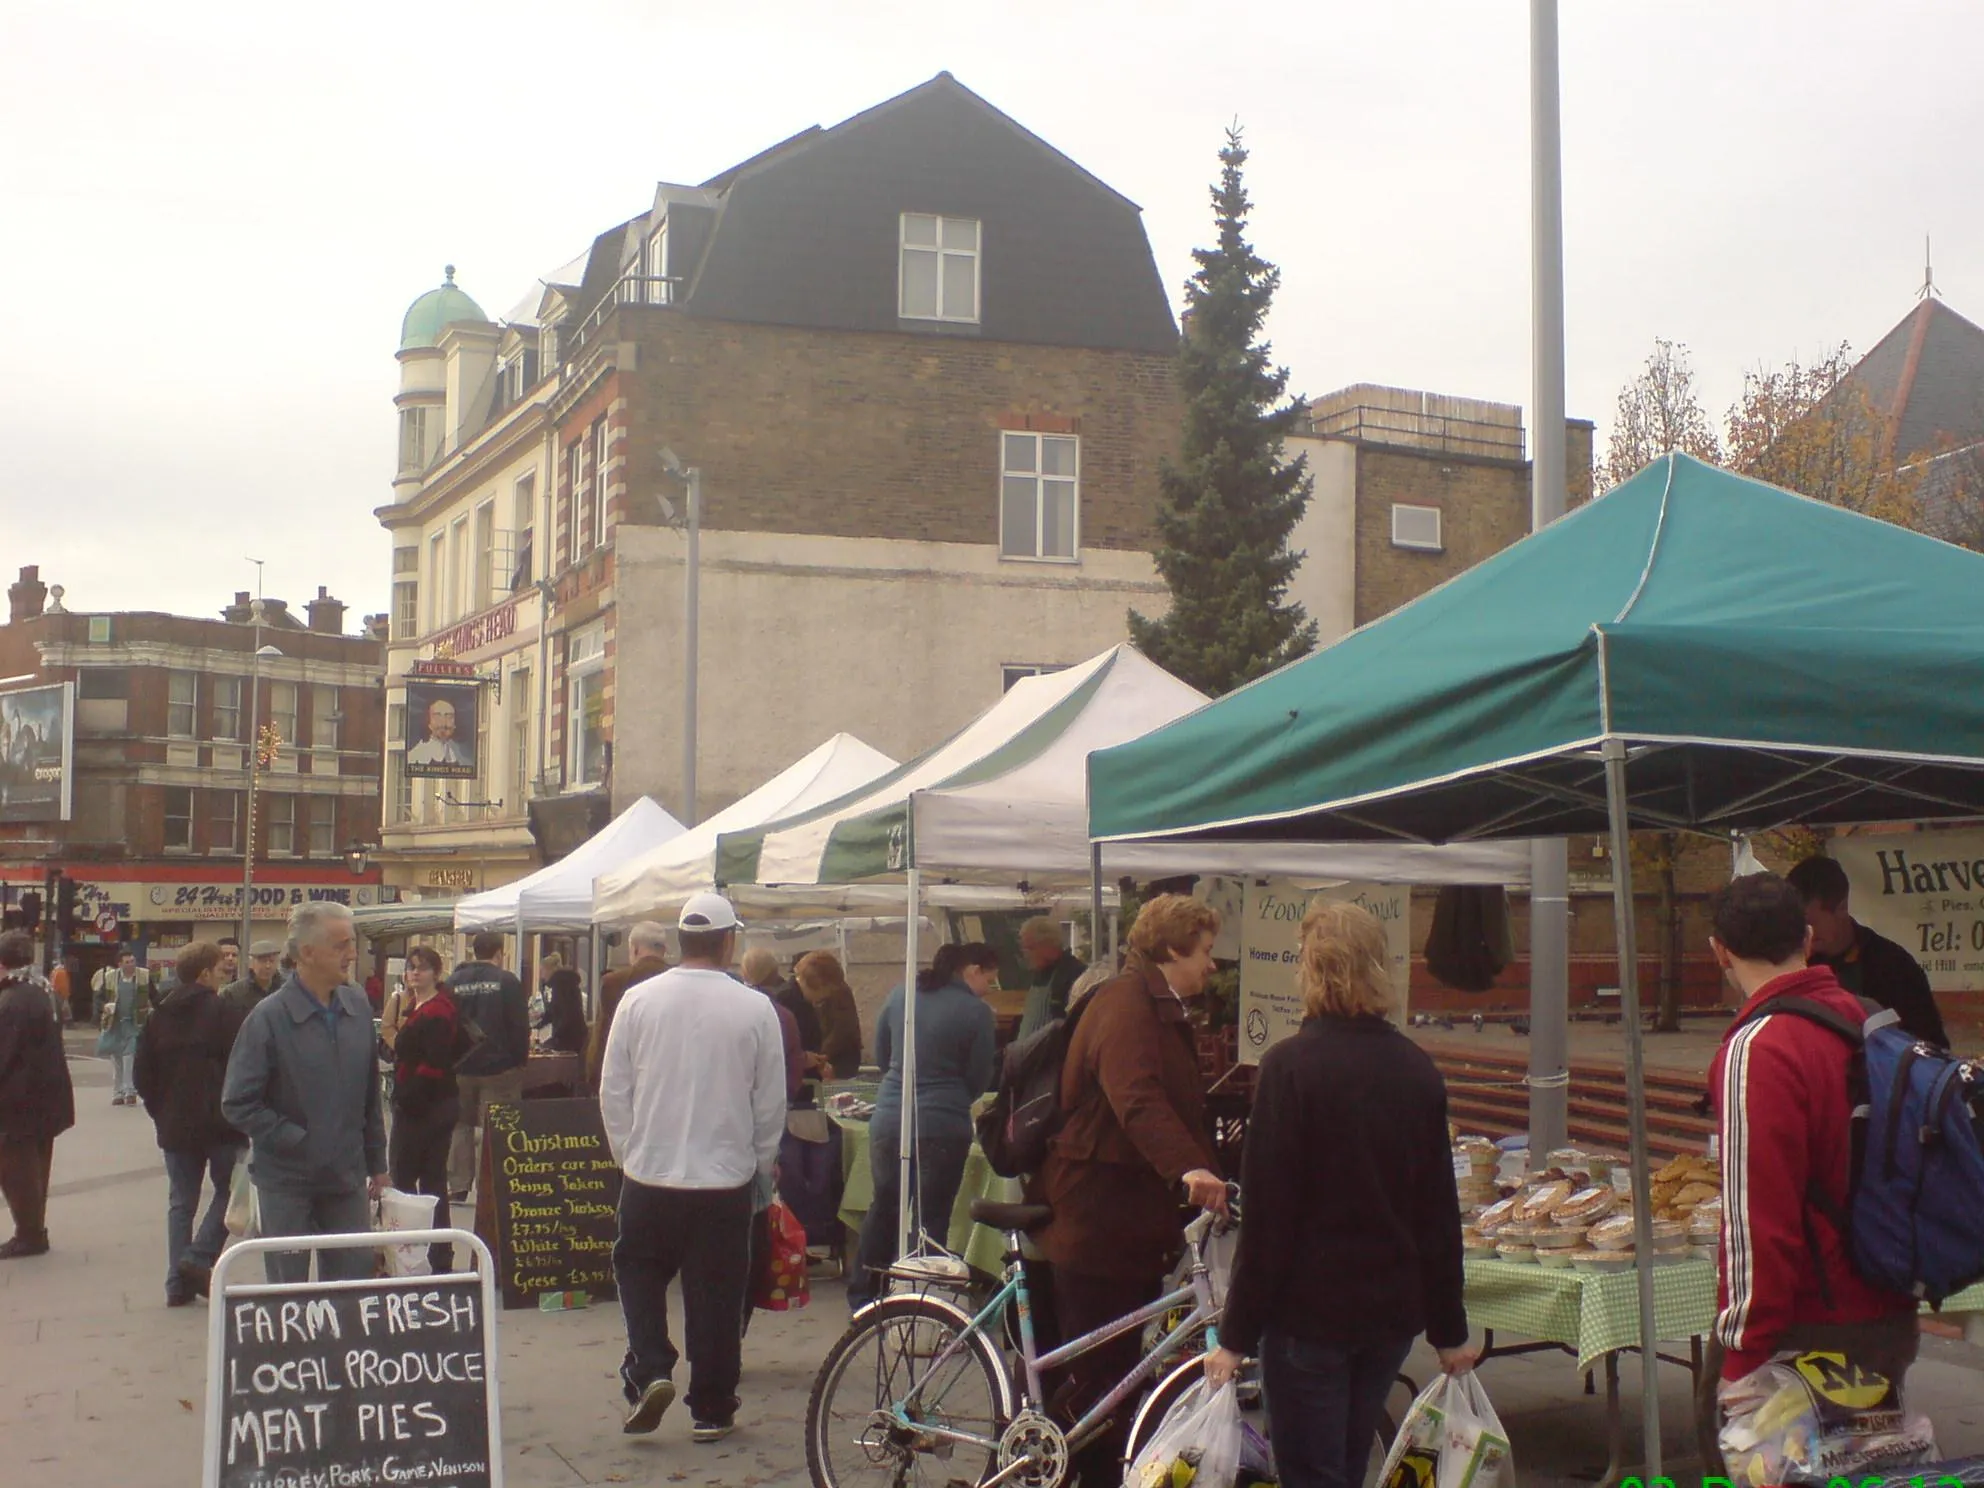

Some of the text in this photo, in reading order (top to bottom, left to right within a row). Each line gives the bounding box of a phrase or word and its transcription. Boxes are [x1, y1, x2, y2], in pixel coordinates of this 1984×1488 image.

[486, 604, 516, 643] HEAD
[410, 765, 424, 773] THE
[1876, 849, 1984, 895] Harve
[174, 886, 199, 906] 24
[235, 887, 285, 905] FOOD
[290, 887, 304, 905] &
[308, 888, 351, 904] WINE
[1259, 894, 1307, 921] Food
[1916, 921, 1962, 952] Tel:
[1249, 946, 1278, 962] Home
[1935, 959, 1957, 971] Hill
[507, 1130, 600, 1153] Christmas
[503, 1156, 555, 1176] Orders
[509, 1174, 605, 1197] Being Taken
[510, 1201, 562, 1219] Bronze
[510, 1239, 561, 1254] White
[513, 1271, 558, 1294] Geese
[234, 1292, 476, 1344] FARM FRESH
[230, 1350, 484, 1397] LOCAL PRODUCE
[227, 1402, 447, 1467] MEAT PIES
[433, 1457, 485, 1477] VENISON
